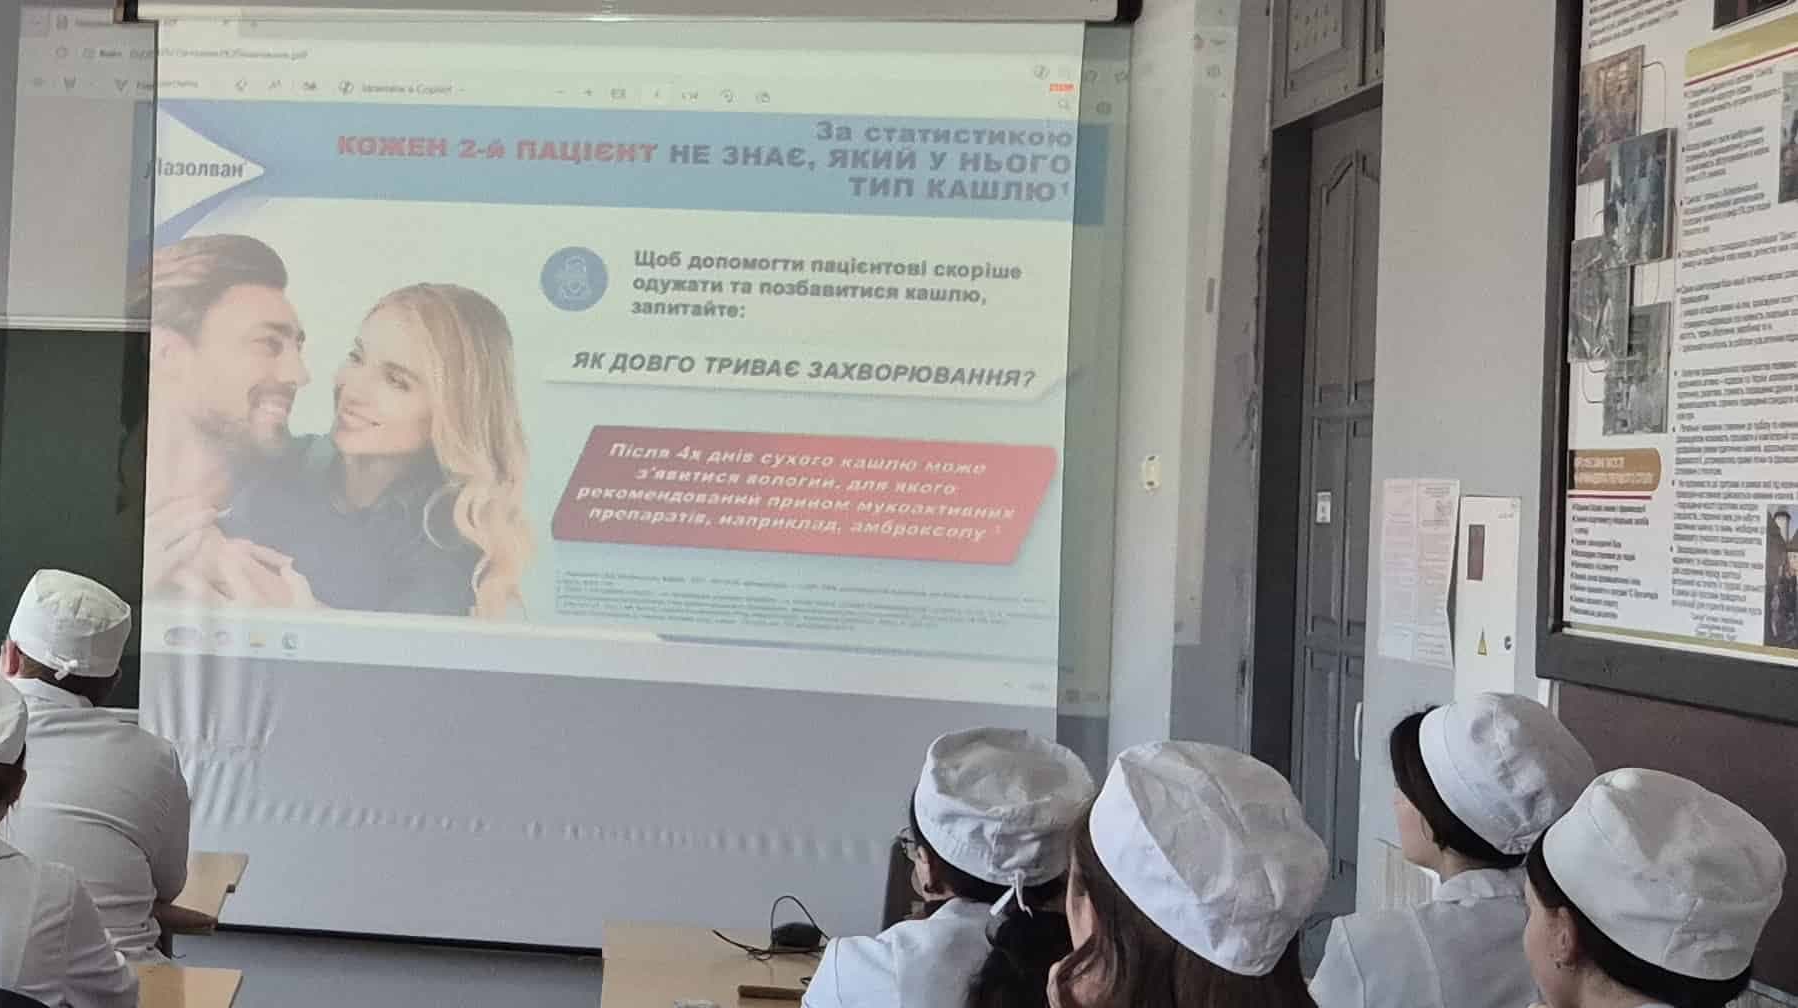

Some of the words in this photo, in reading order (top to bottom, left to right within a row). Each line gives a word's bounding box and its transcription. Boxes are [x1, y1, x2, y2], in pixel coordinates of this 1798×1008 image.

[815, 120, 853, 143] За
[863, 125, 1073, 147] статистикою
[337, 135, 448, 158] КОЖЕН
[515, 139, 659, 165] ПАЦІЄНТ
[668, 144, 711, 166] НЕ
[722, 145, 816, 171] ЗНАЄ,
[828, 145, 918, 171] ЯКИЙ
[928, 151, 949, 171] У
[959, 152, 1072, 175] НЬОГО
[848, 175, 915, 199] ТИП
[633, 249, 682, 271] Щоб
[687, 253, 804, 273] допомогти
[810, 258, 927, 277] пацієнтові
[933, 261, 1023, 282] скоріше
[632, 276, 724, 296] одужати
[729, 280, 753, 296] та
[759, 278, 900, 299] позбавитися
[904, 287, 988, 305] кашлю,
[630, 301, 747, 319] запитайте:
[571, 351, 606, 370] ЯК
[608, 352, 696, 374] ДОВГО
[704, 355, 803, 379] ТРИВАЄ
[807, 360, 1037, 388] ЗАХВОРЮВАННЯ?
[608, 442, 671, 459] Після
[705, 448, 755, 465] днів
[760, 452, 834, 468] сухого
